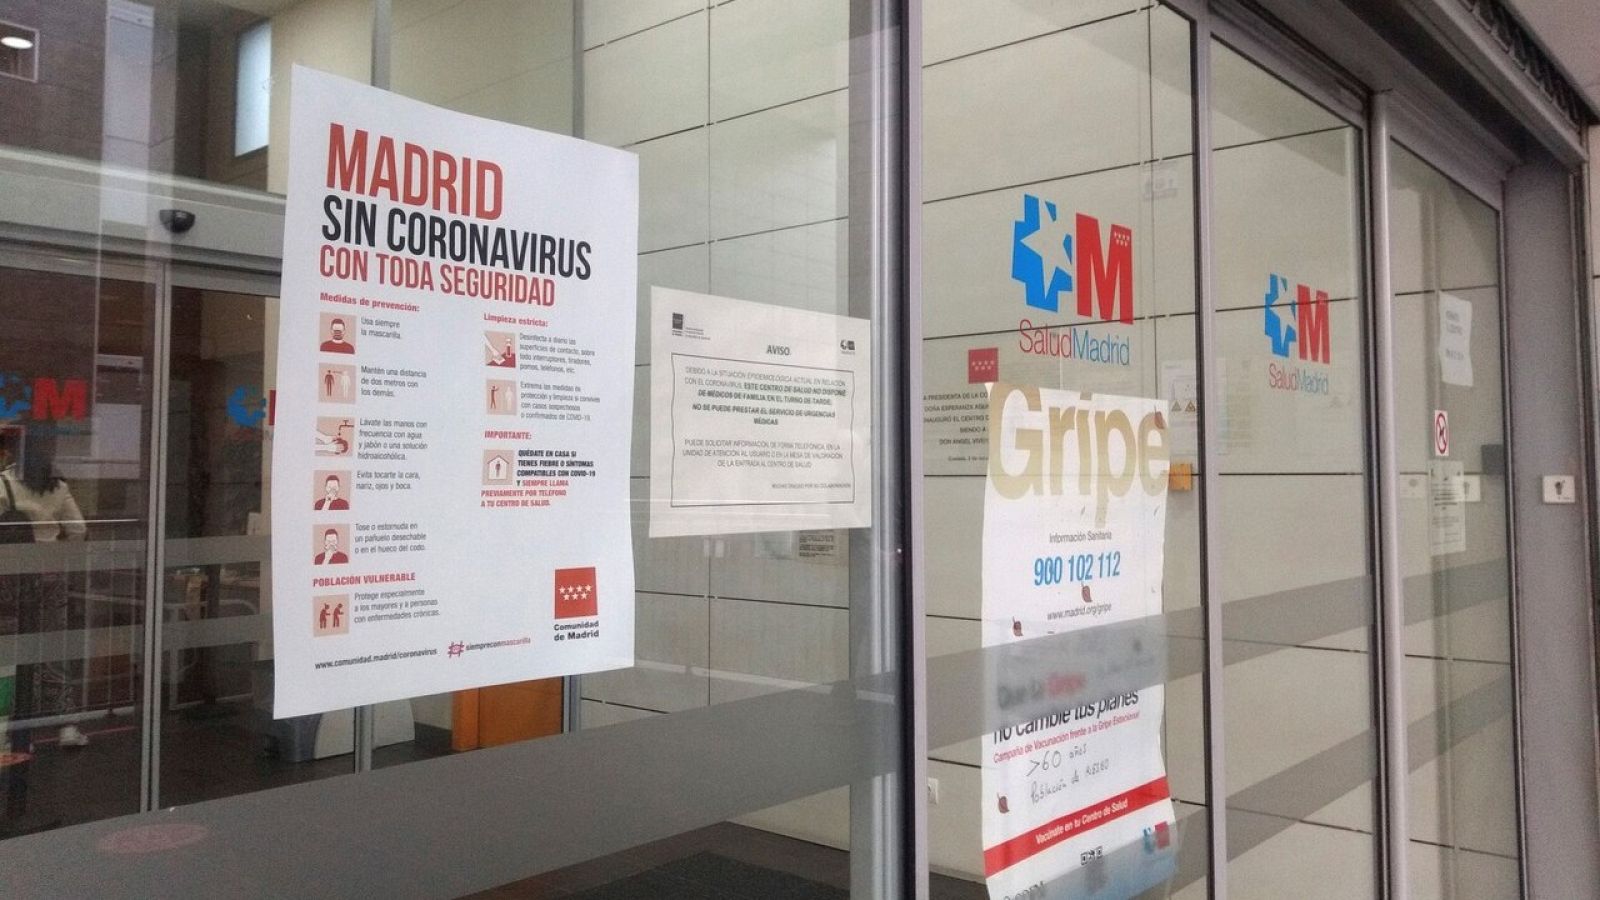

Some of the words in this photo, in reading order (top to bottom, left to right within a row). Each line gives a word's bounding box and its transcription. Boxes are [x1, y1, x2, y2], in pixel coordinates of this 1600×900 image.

[326, 122, 503, 221] MADRID
[322, 194, 377, 248] SIN
[387, 207, 591, 281] CORONAVIRUS
[1076, 212, 1134, 325] M
[319, 244, 368, 282] CON
[376, 253, 434, 292] TODA
[440, 263, 555, 307] SEGURIDAD
[320, 292, 356, 304] Medidas
[360, 298, 369, 306] de
[372, 302, 420, 312] prevención:
[375, 319, 400, 328] siempre
[484, 313, 516, 324] Limpieza
[518, 317, 548, 327] estricta:
[1297, 284, 1330, 365] M
[1019, 319, 1130, 366] SaludMadrid
[400, 369, 426, 378] distancia
[384, 379, 406, 387] metros
[372, 389, 395, 397] demás.
[359, 429, 392, 438] frecuencia
[407, 431, 422, 439] agua
[485, 431, 532, 440] IMPORTANTE:
[364, 441, 382, 449] jabón
[518, 449, 544, 457] QUÉDATE
[988, 382, 1170, 529] Gripe
[566, 459, 594, 467] SÍNTOMAS
[376, 482, 389, 491] ojos
[365, 534, 390, 543] pañuelo
[392, 533, 426, 541] desechable
[1049, 531, 1086, 544] Información
[1087, 530, 1112, 541] Sanitaria
[399, 544, 408, 552] del
[1034, 556, 1063, 586] 900
[1069, 554, 1093, 582] 102
[1098, 551, 1121, 578] 112
[313, 576, 360, 587] POBLACIÓN
[364, 572, 415, 584] VULNERABLE
[355, 592, 378, 601] Protege
[380, 589, 425, 598] especialmente
[371, 602, 397, 612] mayores
[410, 599, 438, 608] personas
[368, 612, 411, 622] enfermedades
[1047, 603, 1112, 621] www.madrid.org/gripe
[553, 620, 599, 631] Comunidad
[554, 633, 565, 641] de
[567, 630, 599, 639] Madrid
[315, 648, 437, 669] www.comunidad.madrid/coronavirus
[1065, 822, 1073, 832] en
[1075, 818, 1081, 827] tu
[1082, 811, 1101, 824] Centro
[1103, 806, 1111, 816] de
[1111, 798, 1128, 813] Salud
